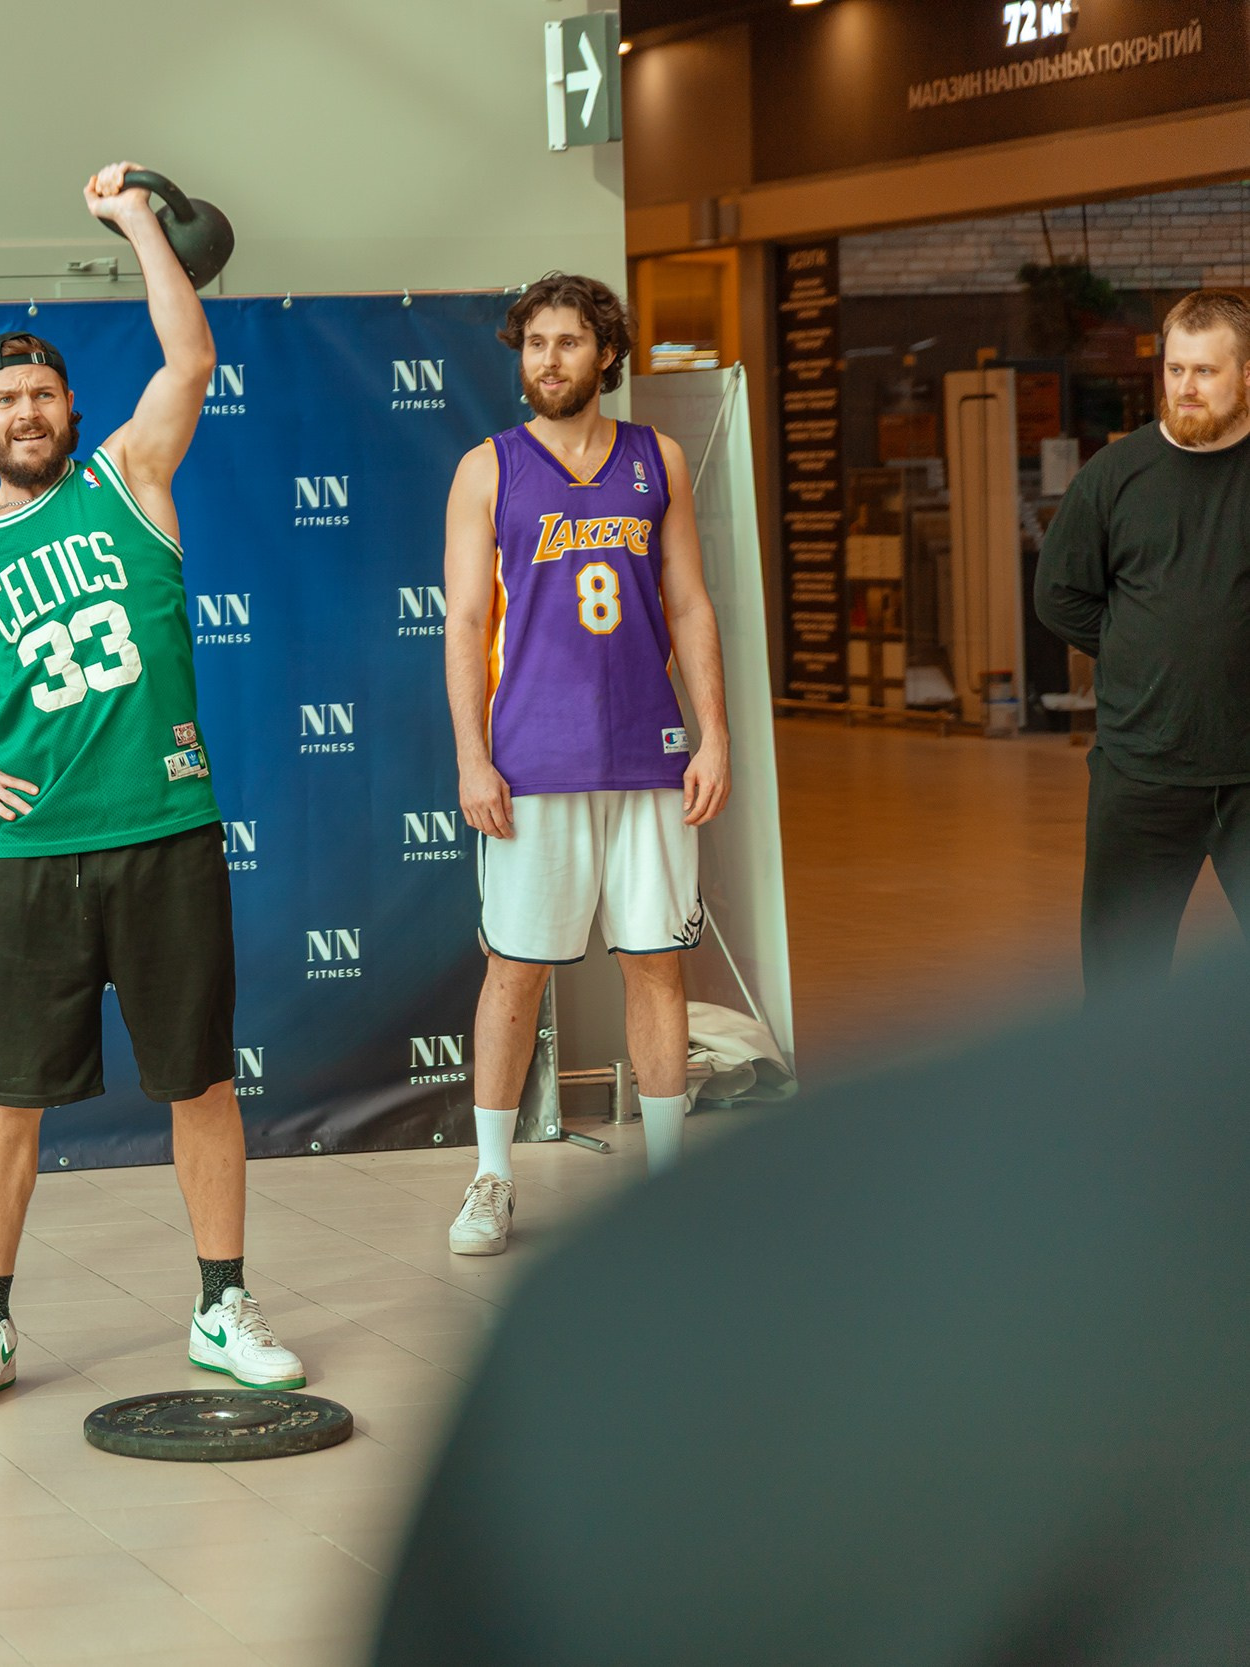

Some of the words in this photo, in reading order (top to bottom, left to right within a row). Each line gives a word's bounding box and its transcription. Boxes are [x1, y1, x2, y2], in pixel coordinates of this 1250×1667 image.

[1003, 0, 1038, 47] 72
[908, 71, 982, 110] МАГАЗИН
[985, 46, 1095, 94] НАПОЛЬНЫХ
[1098, 18, 1202, 72] ПОКРЫТИЙ
[392, 360, 444, 392] NN
[199, 404, 246, 415] TNESS
[391, 398, 446, 410] FITNESS
[295, 476, 349, 509] NN
[294, 515, 350, 527] FITNESS
[532, 512, 652, 564] LAKERS
[196, 593, 250, 627] NN
[398, 586, 447, 619] NN
[576, 561, 622, 635] 8
[196, 633, 252, 645] FITNESS
[398, 625, 445, 637] FITNES
[17, 599, 143, 713] 33
[300, 703, 354, 736] NN
[178, 756, 187, 768] M
[300, 742, 356, 754] FITNESS
[403, 810, 457, 844] NN
[403, 850, 458, 862] FITNESS
[306, 928, 360, 962] NN
[306, 967, 362, 980] FITNESS
[410, 1034, 464, 1068] NN
[410, 1072, 467, 1085] FITNESS
